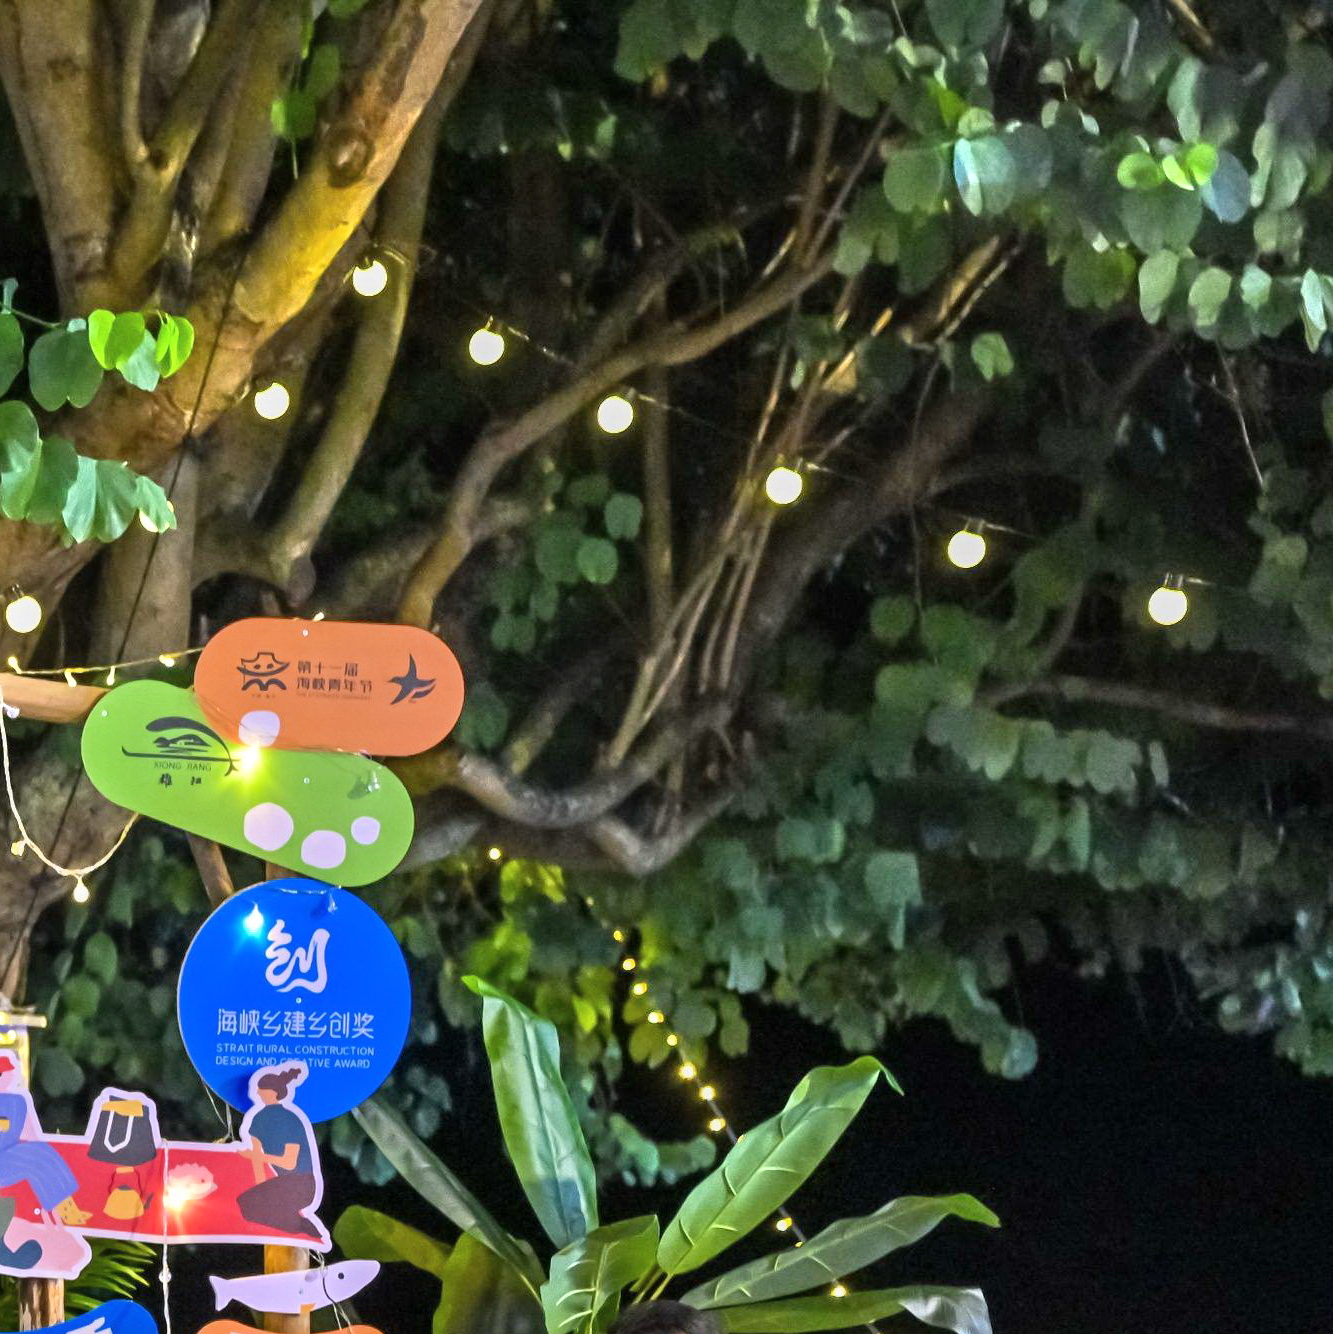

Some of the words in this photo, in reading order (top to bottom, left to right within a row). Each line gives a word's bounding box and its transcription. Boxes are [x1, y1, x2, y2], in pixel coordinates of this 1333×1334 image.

[154, 761, 182, 770] XIONG
[217, 1008, 375, 1039] 海峡乡建乡创奖
[216, 1043, 254, 1053] STRAIT
[256, 1044, 292, 1055] RURAL
[294, 1045, 375, 1056] CONSTRUCTION
[215, 1055, 254, 1066] DESIGN
[256, 1057, 277, 1066] AND
[334, 1059, 371, 1069] AWARD
